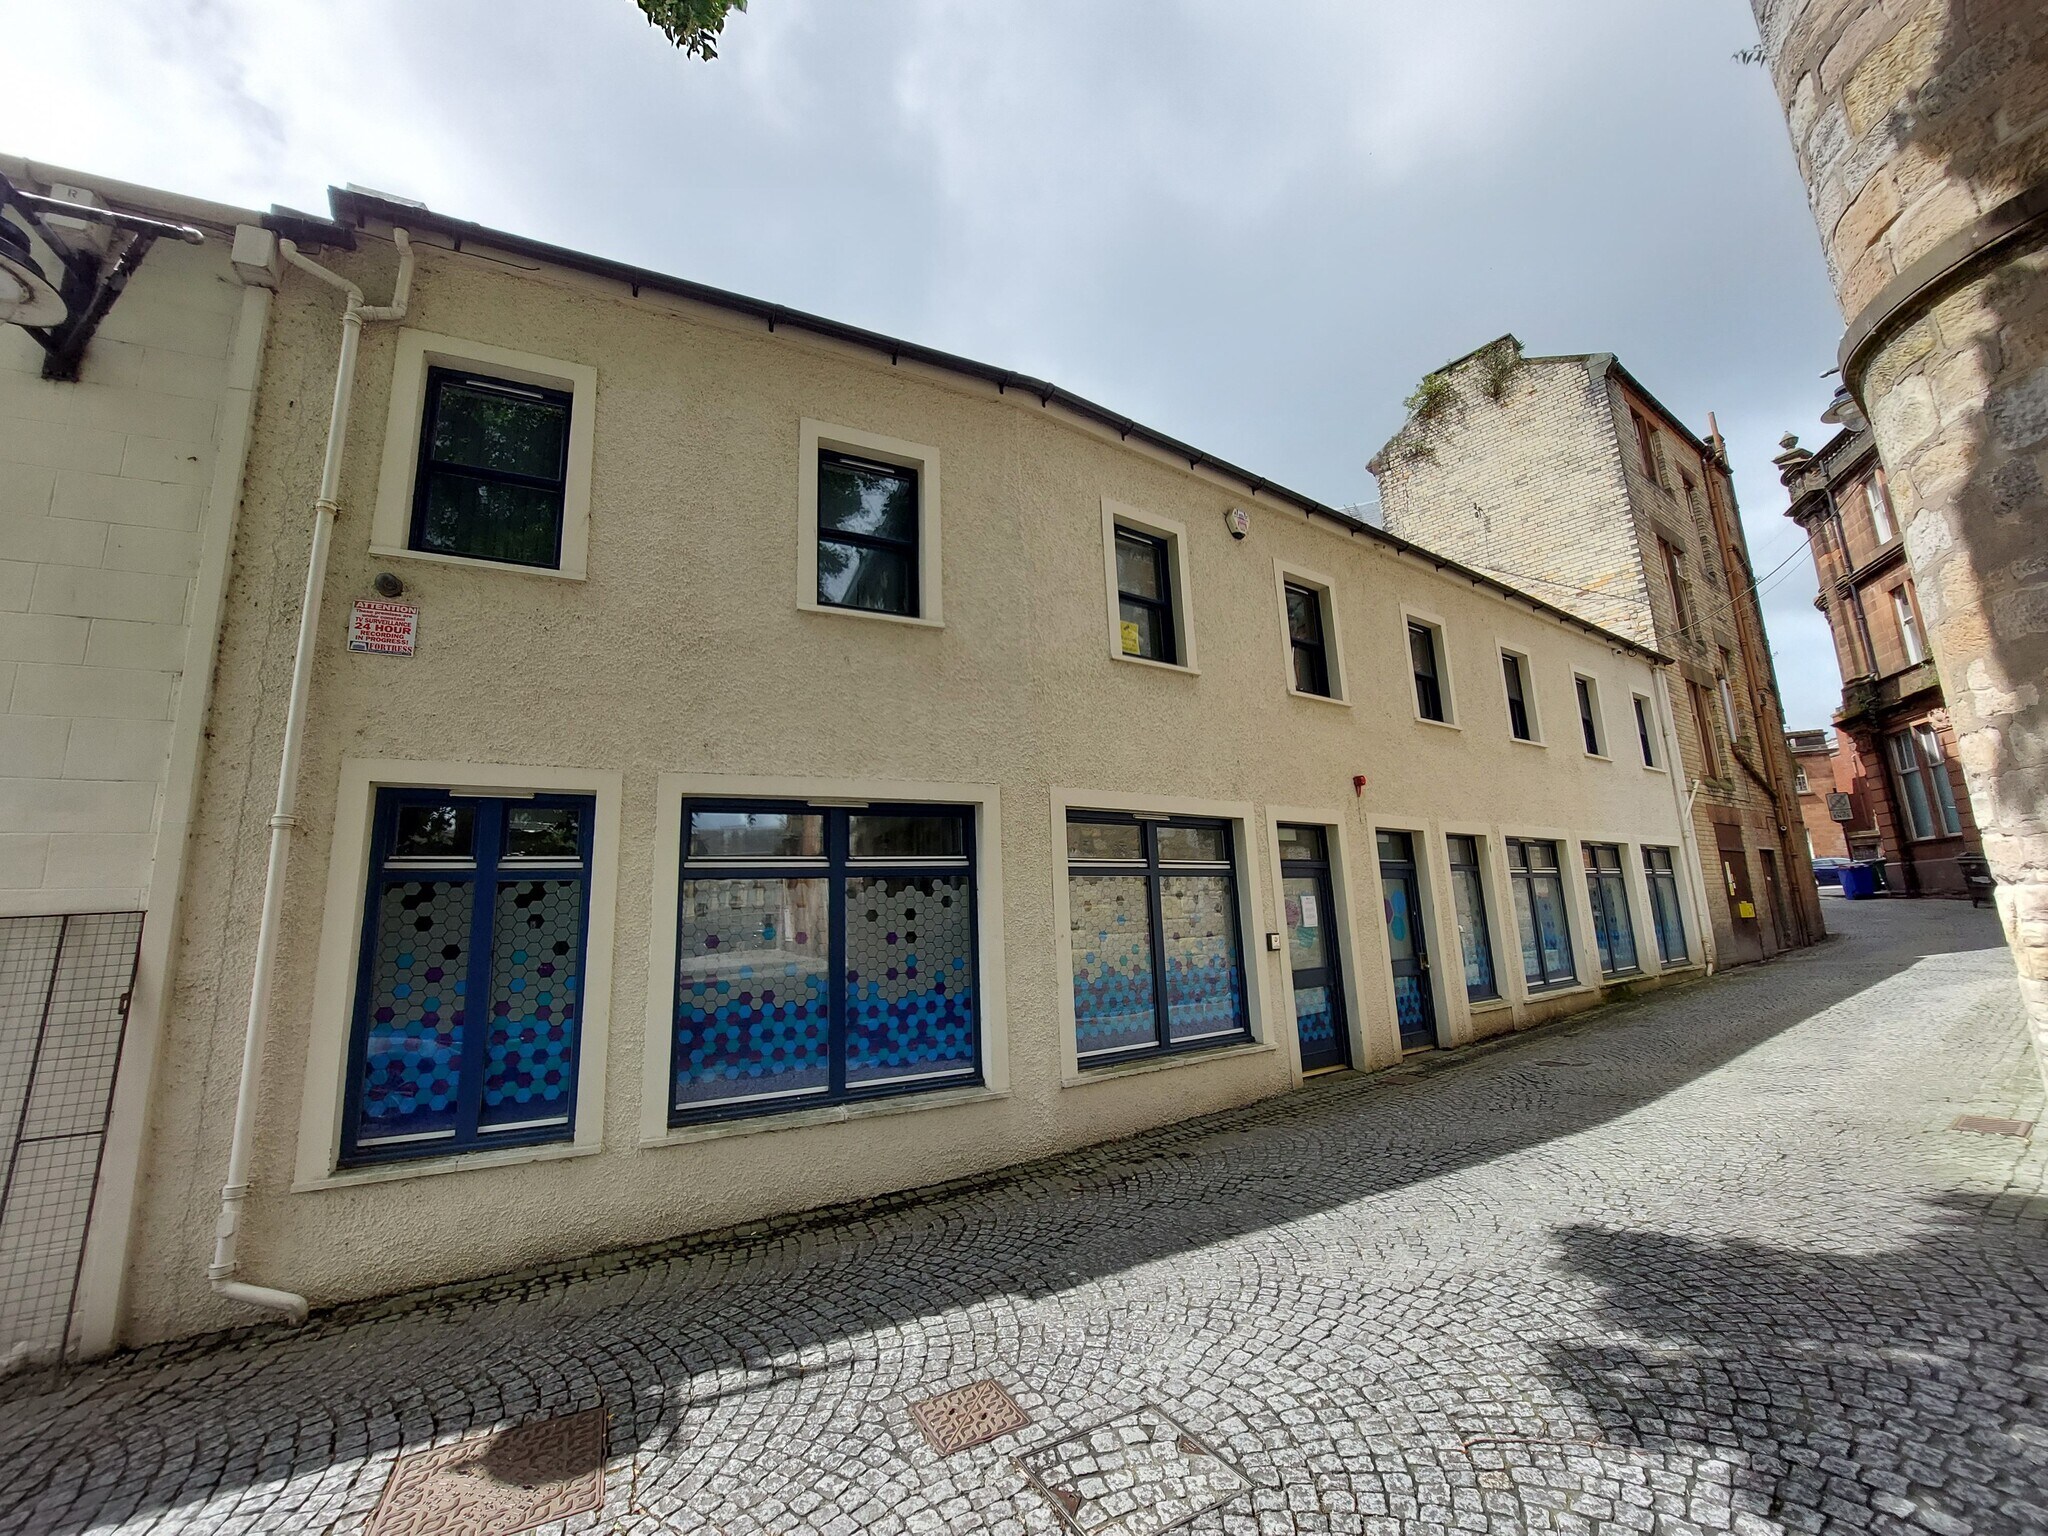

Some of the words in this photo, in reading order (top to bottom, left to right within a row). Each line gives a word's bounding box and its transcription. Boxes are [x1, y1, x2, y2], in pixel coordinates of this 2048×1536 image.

[356, 601, 416, 613] ATTENTION
[365, 618, 411, 627] SURVEILLANCE
[354, 622, 371, 630] 24
[375, 625, 411, 634] HOUR
[360, 630, 404, 639] RECORDING
[366, 636, 408, 645] PROGRESS!
[370, 643, 412, 652] FORTRESS
